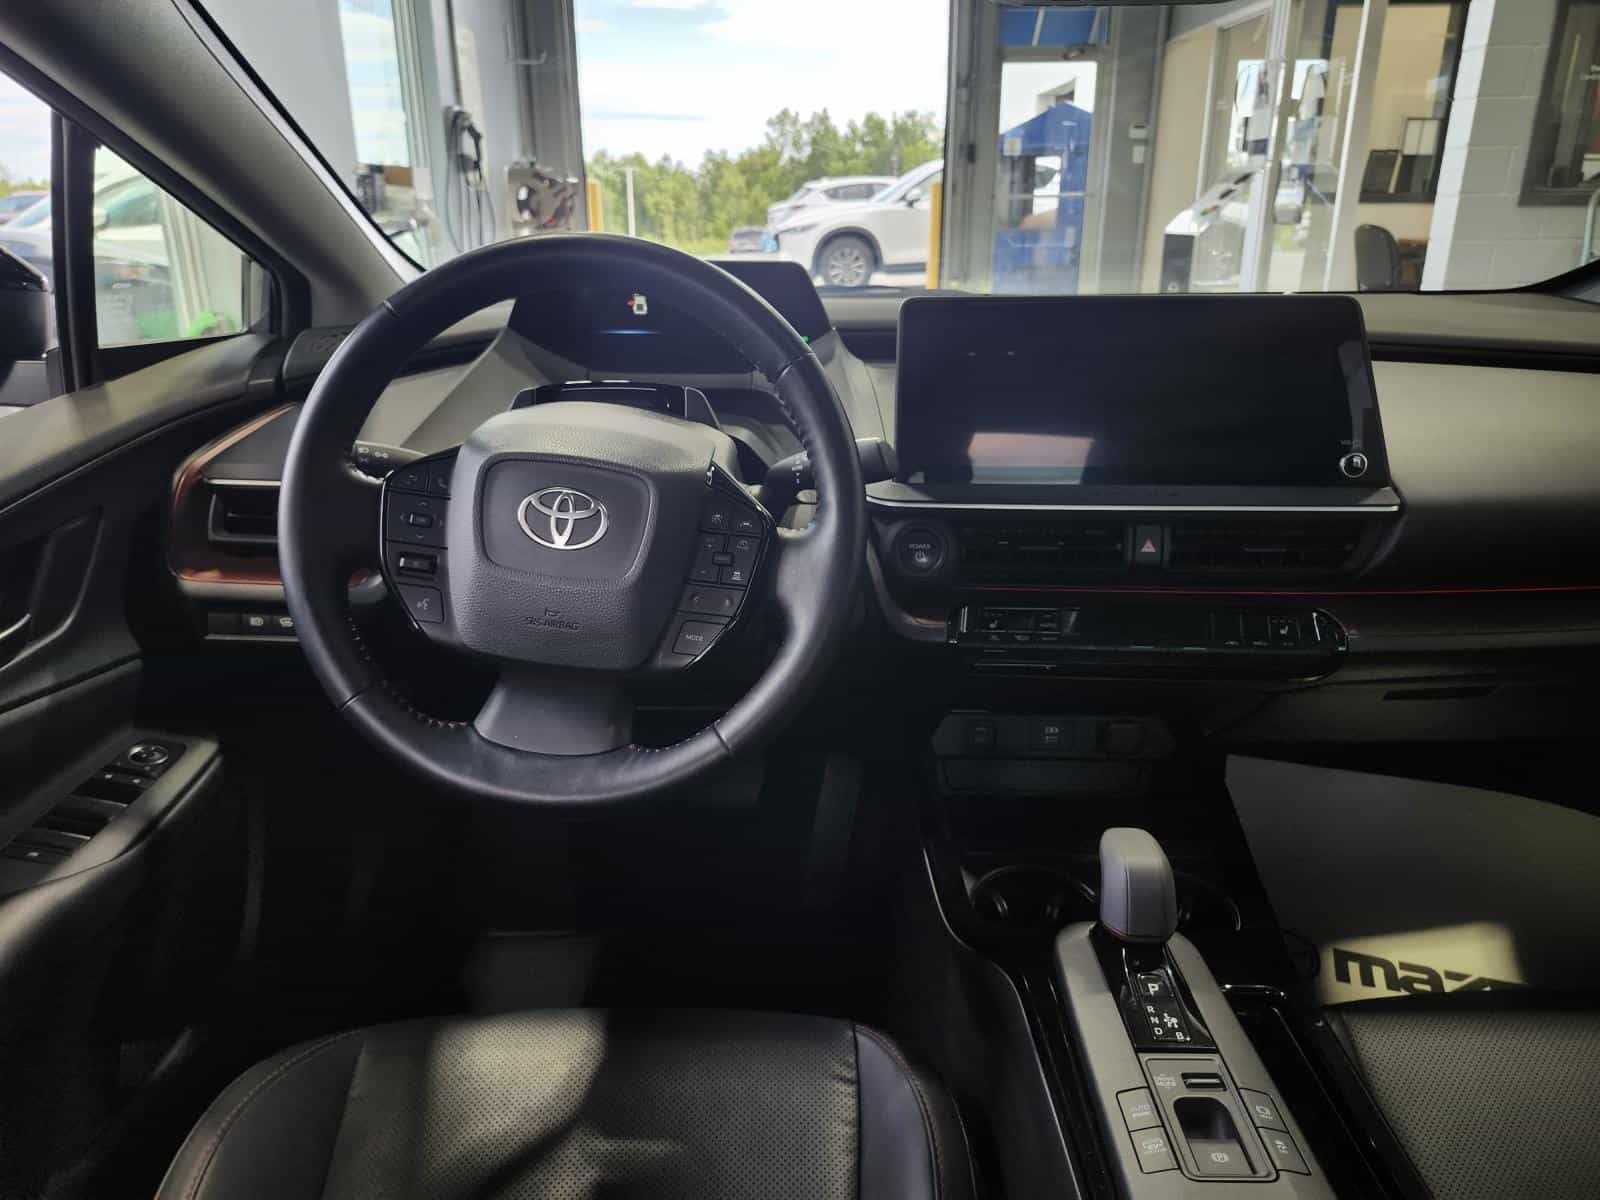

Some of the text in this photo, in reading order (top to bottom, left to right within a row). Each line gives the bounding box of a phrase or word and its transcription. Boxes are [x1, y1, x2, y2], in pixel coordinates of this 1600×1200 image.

[1147, 982, 1160, 997] P
[1146, 1005, 1156, 1014] R
[1149, 1015, 1160, 1025] N
[1153, 1027, 1164, 1036] D
